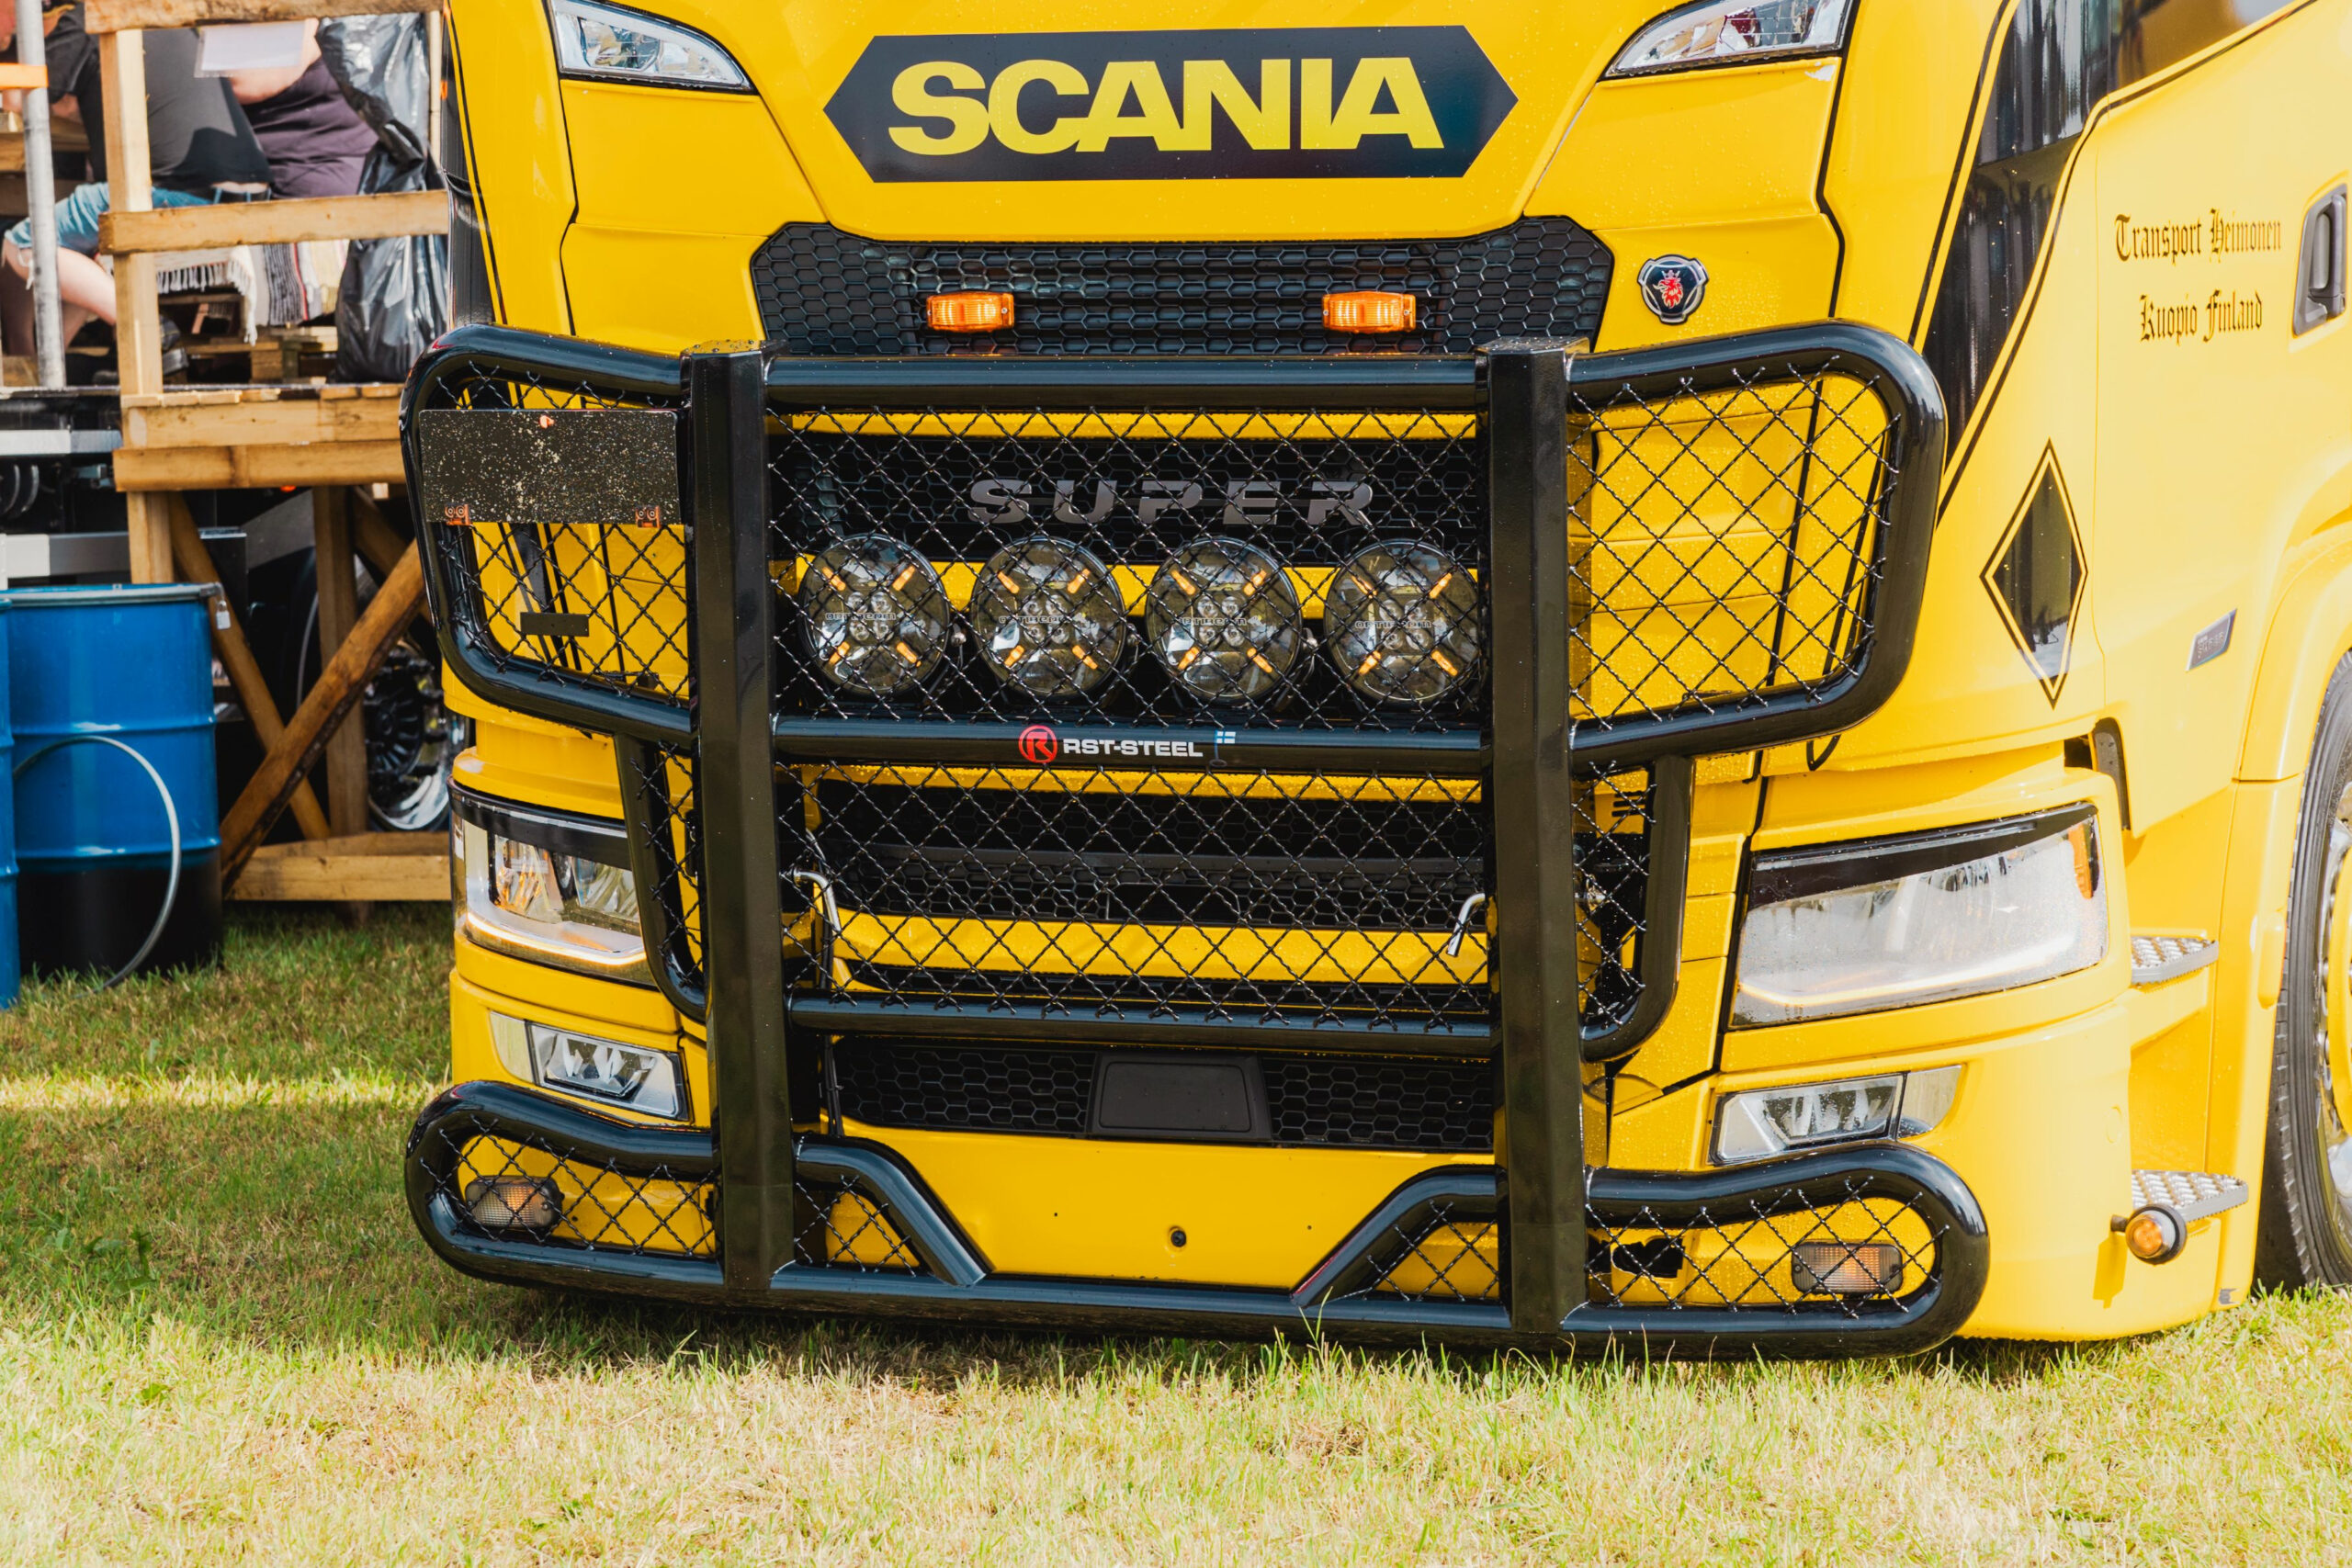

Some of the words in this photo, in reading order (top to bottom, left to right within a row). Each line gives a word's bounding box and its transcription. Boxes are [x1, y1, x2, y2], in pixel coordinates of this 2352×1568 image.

[888, 57, 1444, 154] SCANIA
[2115, 214, 2201, 265] Transport
[2140, 293, 2197, 345] Kuopio
[2203, 289, 2262, 343] Finland
[967, 479, 1374, 526] SUPER
[1063, 738, 1204, 757] RST-STEEL
